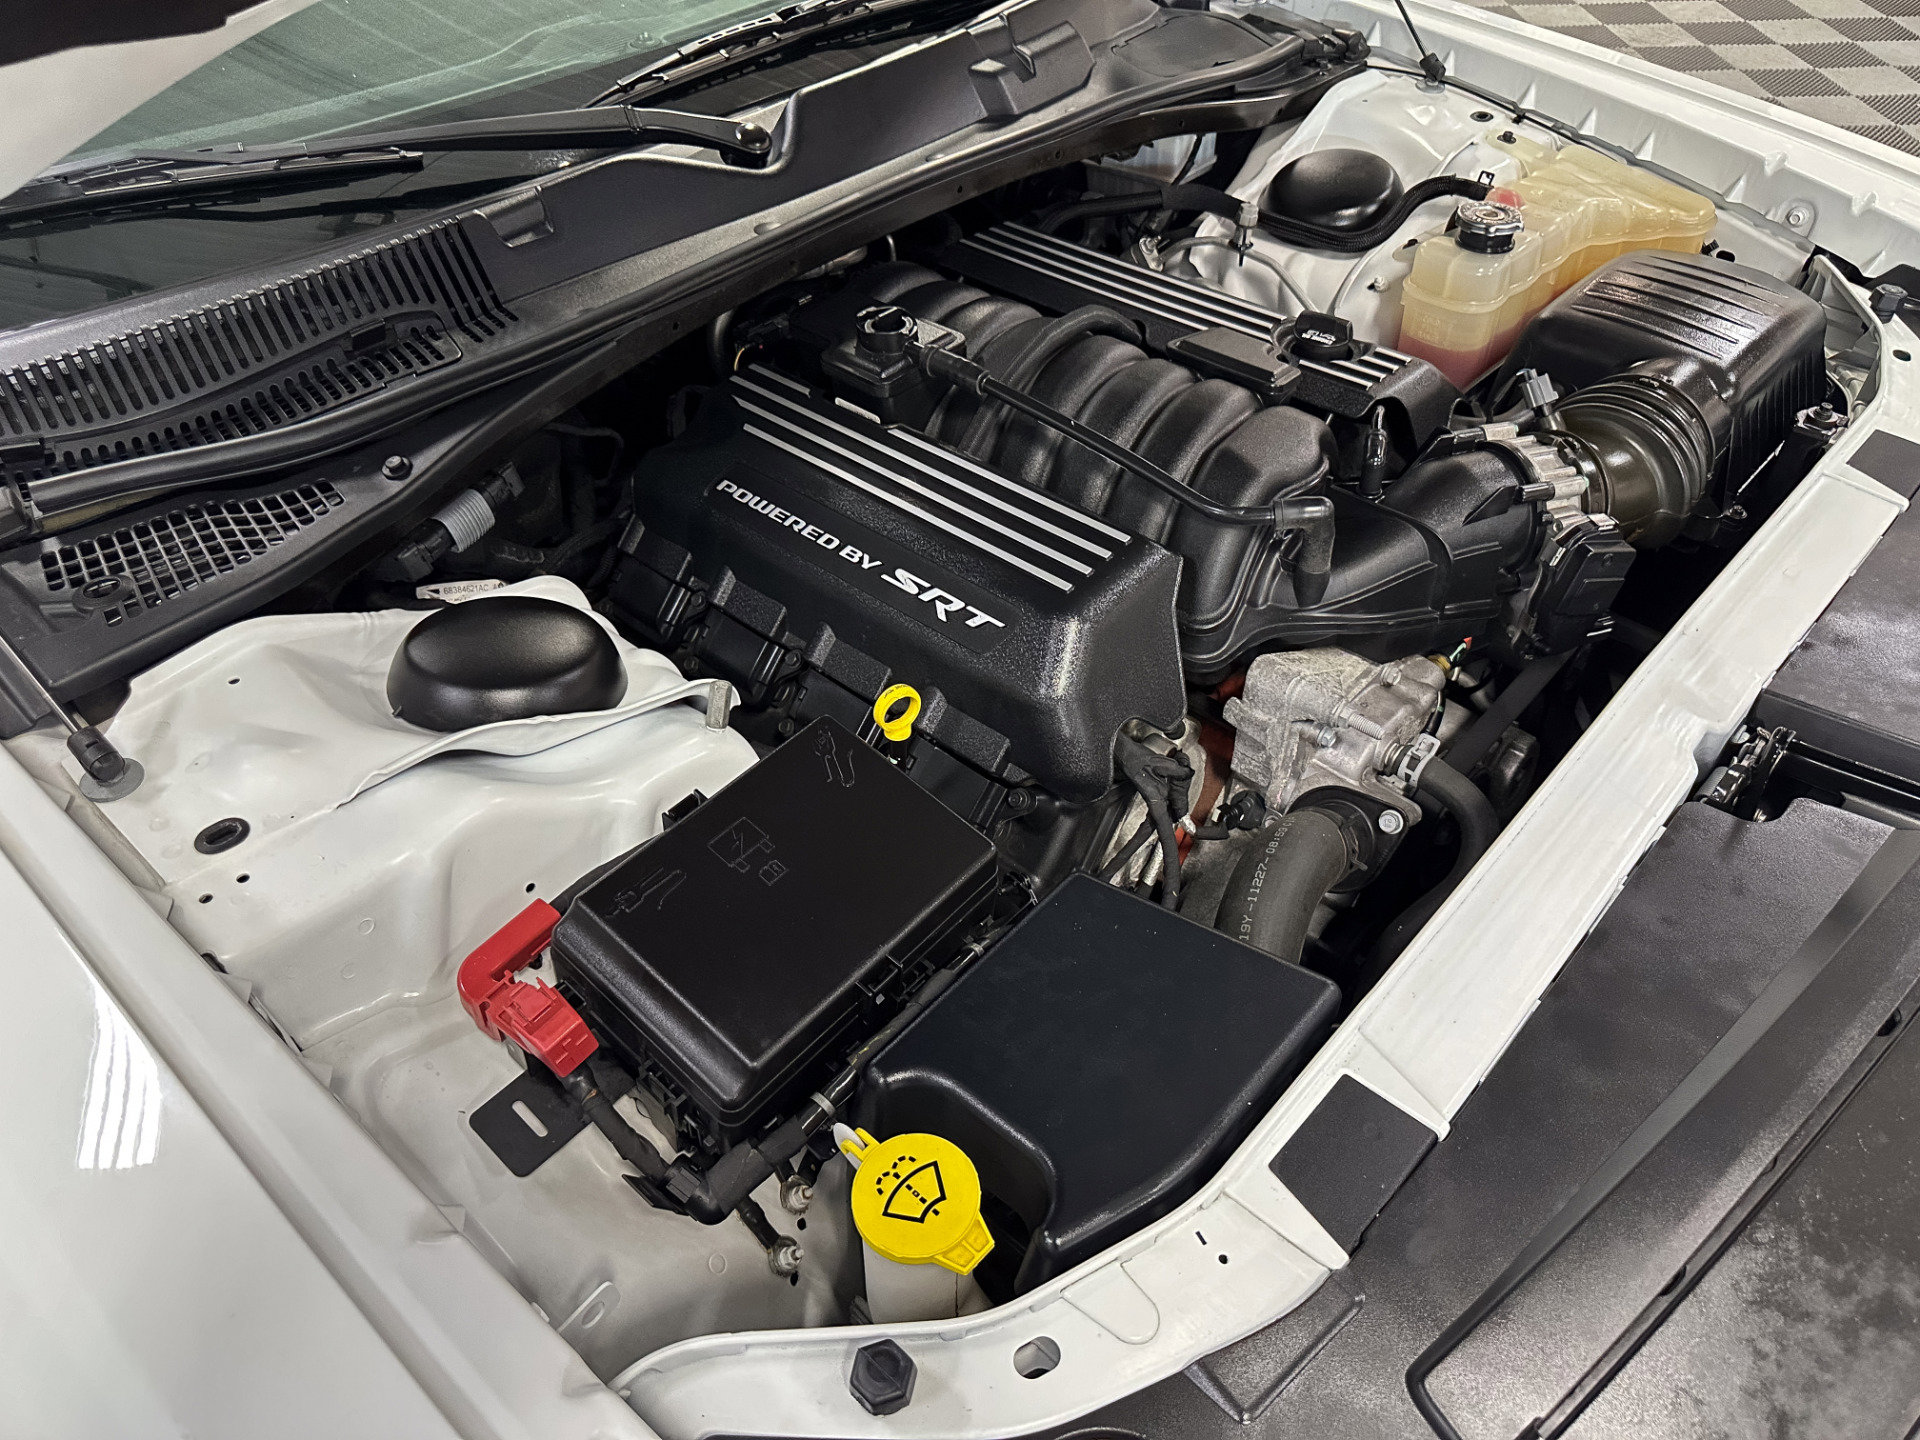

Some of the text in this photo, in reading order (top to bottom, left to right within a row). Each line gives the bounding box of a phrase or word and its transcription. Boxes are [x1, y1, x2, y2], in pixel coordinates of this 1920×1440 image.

[716, 479, 1006, 628] POWERED BY SRT
